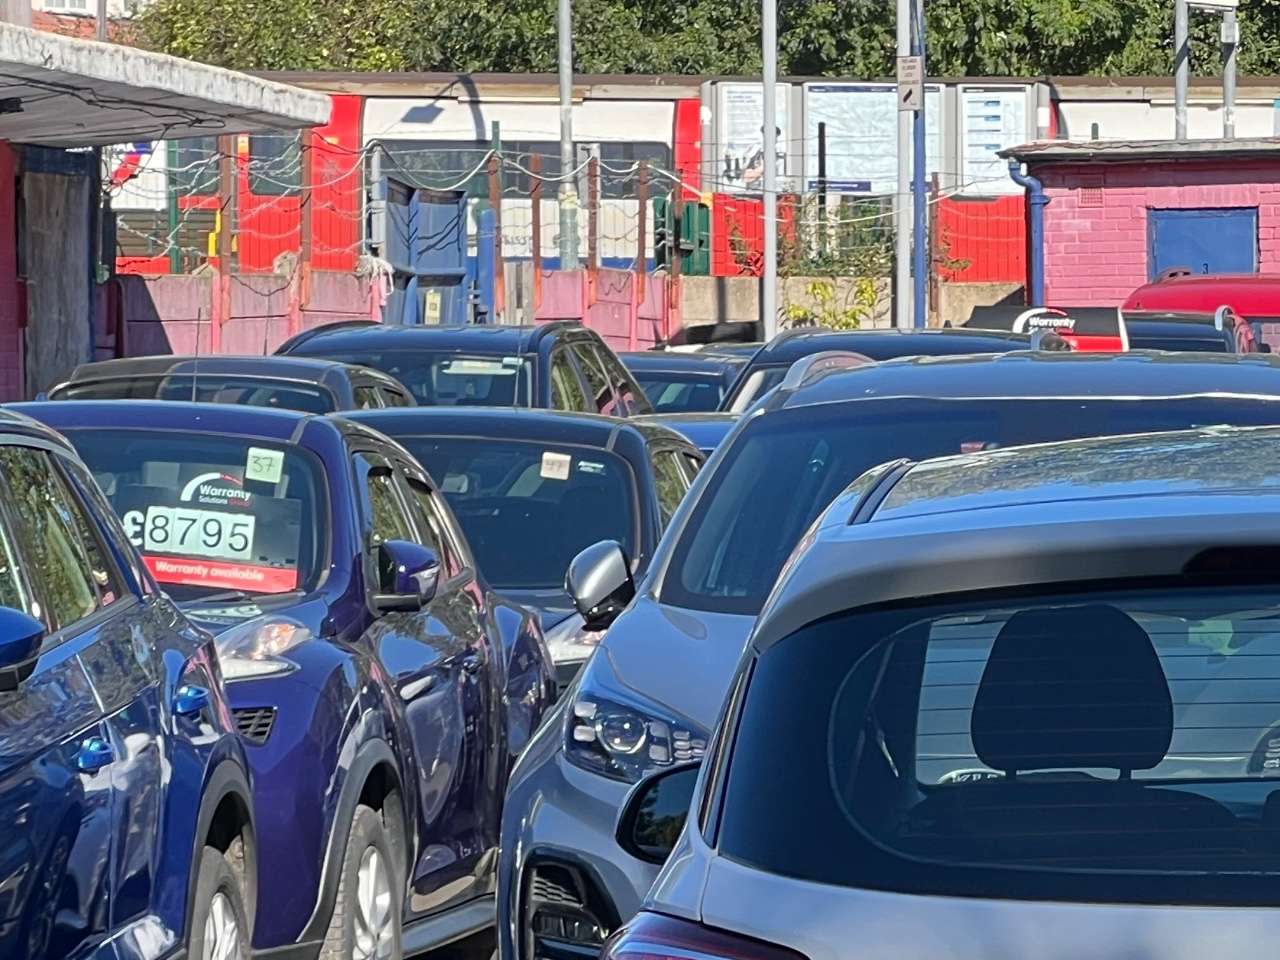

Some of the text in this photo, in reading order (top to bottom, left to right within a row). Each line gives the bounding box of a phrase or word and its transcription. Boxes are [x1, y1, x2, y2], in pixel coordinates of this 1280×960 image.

[1029, 317, 1076, 329] Warranty
[251, 455, 274, 473] 37
[199, 484, 251, 502] Warranty
[155, 561, 264, 581] Warranty available
